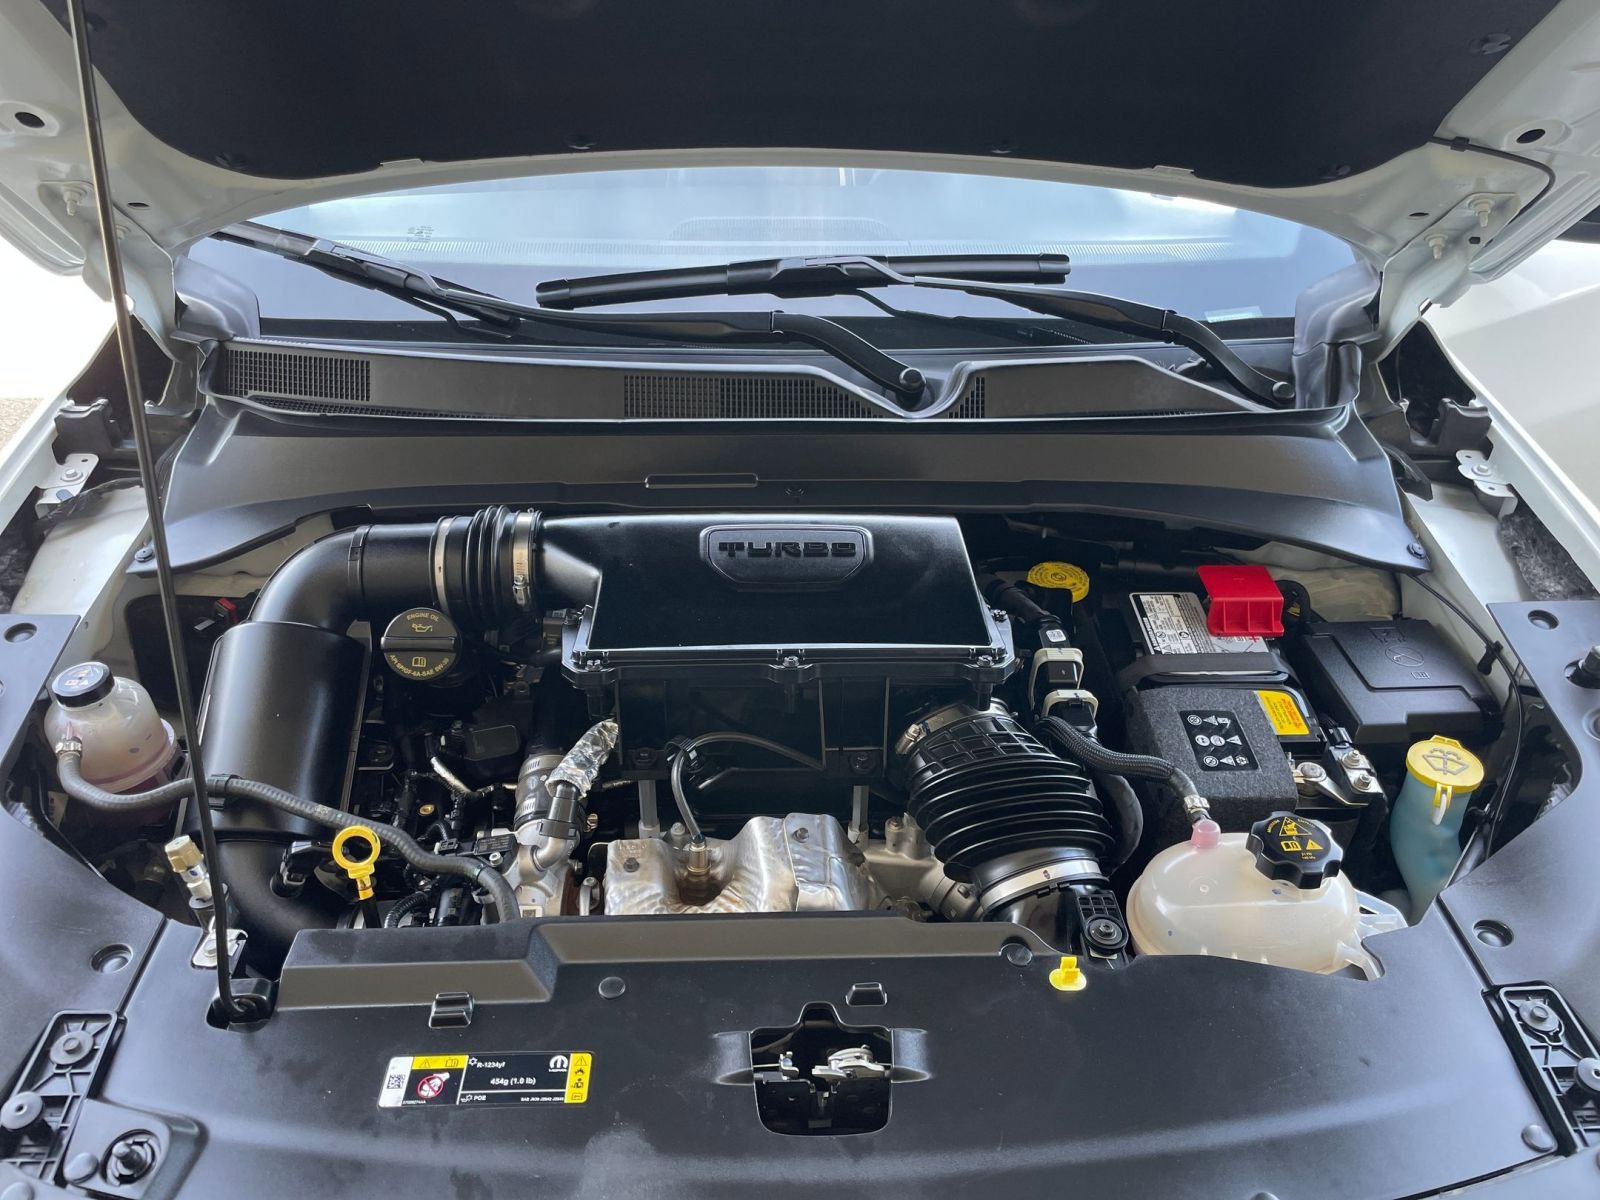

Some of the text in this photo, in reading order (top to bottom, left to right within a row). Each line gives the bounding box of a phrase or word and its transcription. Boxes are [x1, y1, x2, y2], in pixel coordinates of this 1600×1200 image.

[719, 542, 856, 557] TURBO
[477, 1061, 506, 1069] R-1234yf
[490, 1077, 536, 1086] 454g (1.0 lb)
